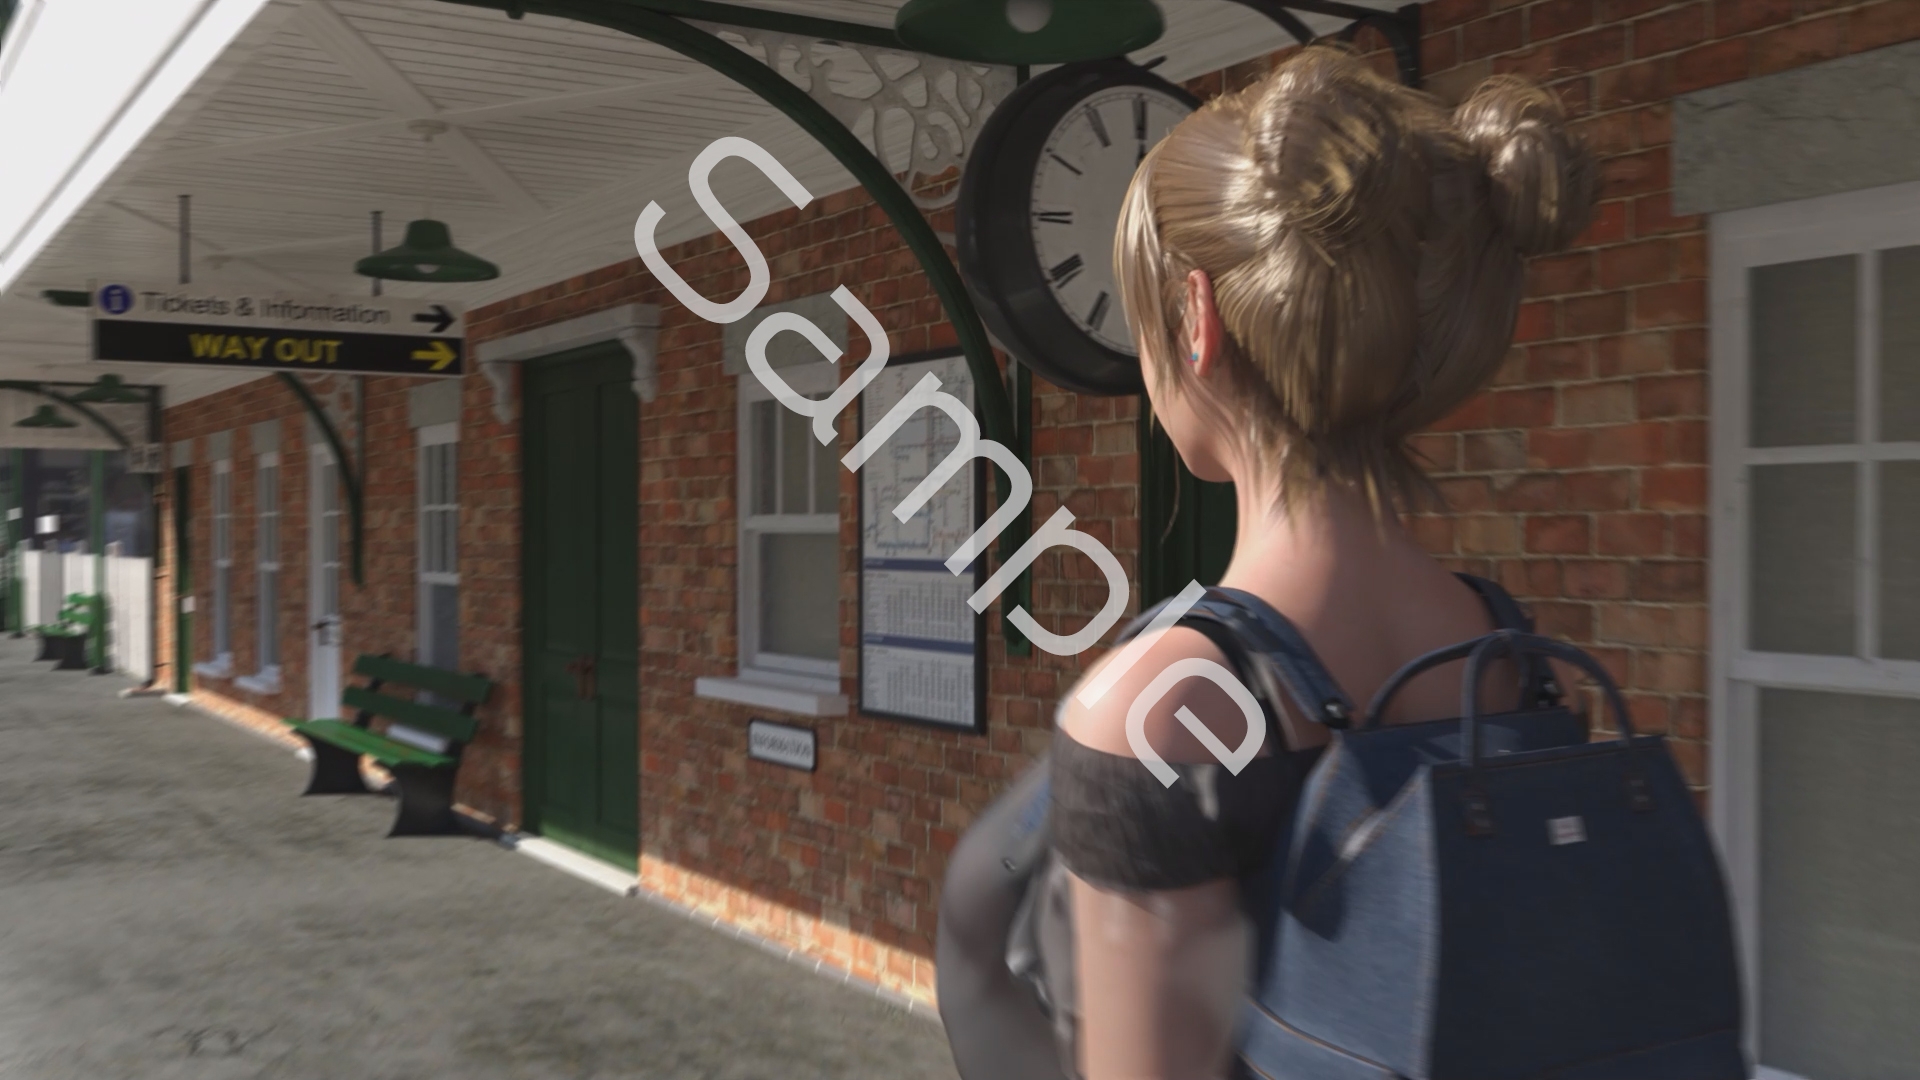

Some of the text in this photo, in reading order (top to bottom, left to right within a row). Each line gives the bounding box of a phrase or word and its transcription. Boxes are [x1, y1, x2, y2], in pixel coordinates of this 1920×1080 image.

[139, 291, 231, 316] Tickets
[234, 296, 254, 316] &
[260, 299, 391, 324] Information
[189, 333, 342, 363] WAY OUT
